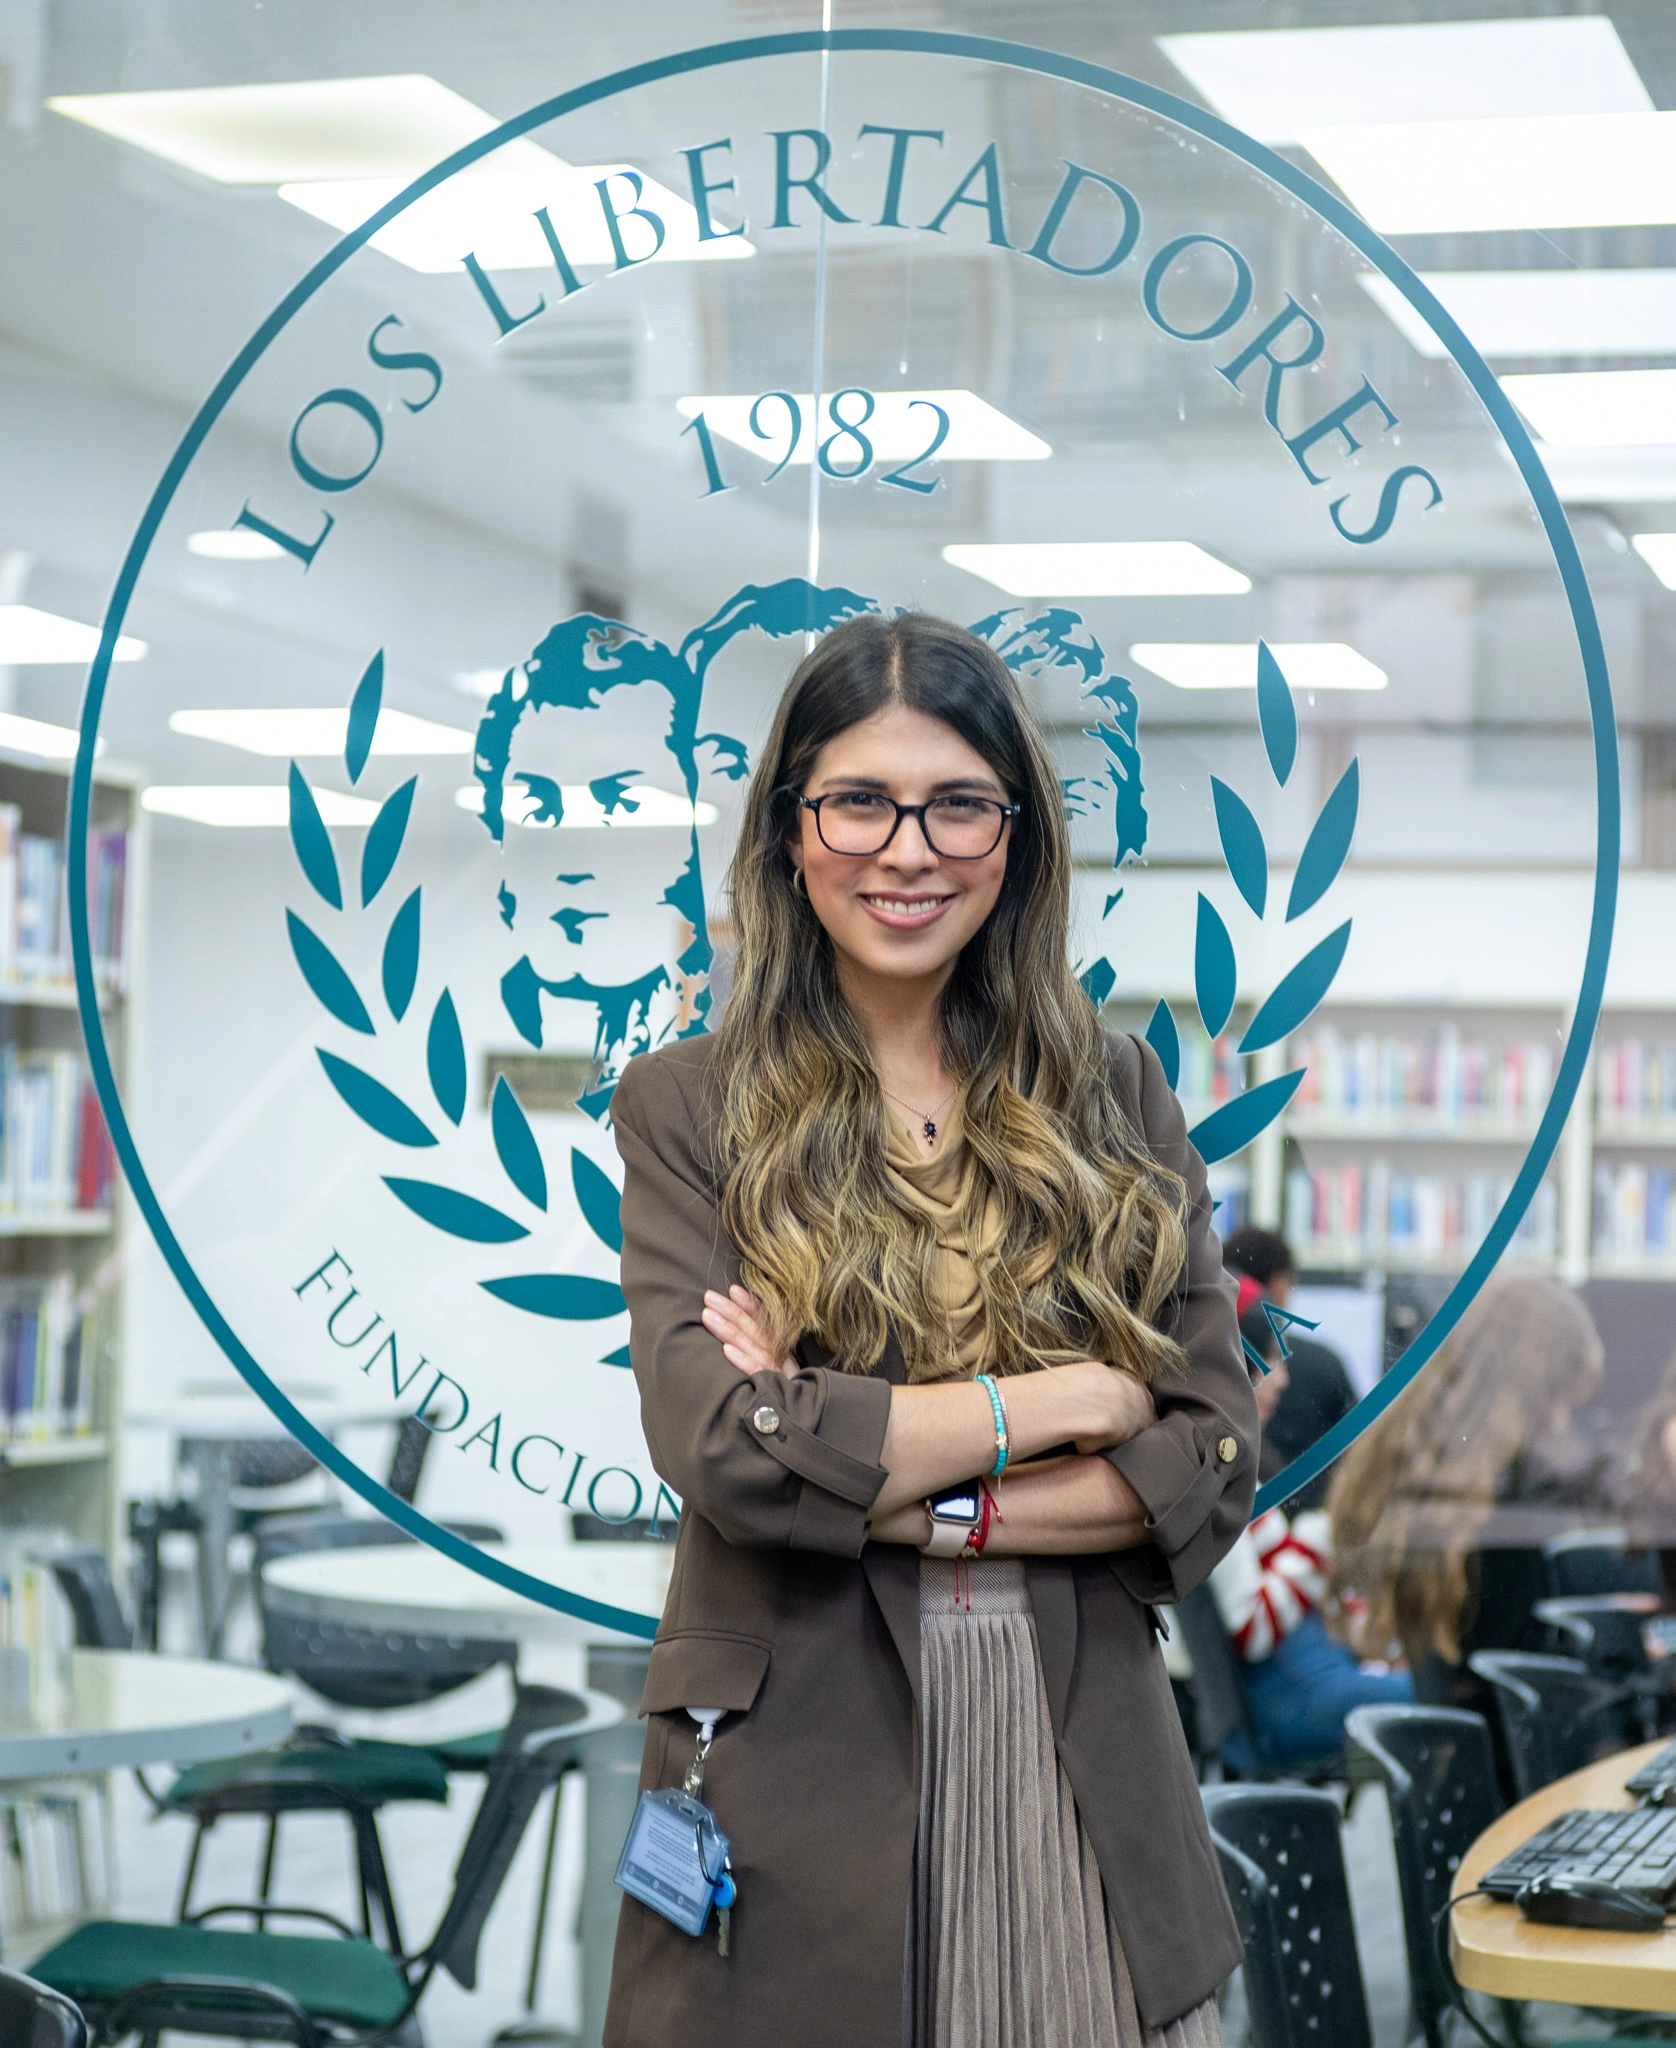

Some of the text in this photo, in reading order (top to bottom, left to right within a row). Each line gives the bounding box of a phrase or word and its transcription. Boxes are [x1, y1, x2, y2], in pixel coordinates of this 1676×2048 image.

[231, 124, 1444, 574] LOS LIBERTADORES
[679, 389, 951, 498] 1982
